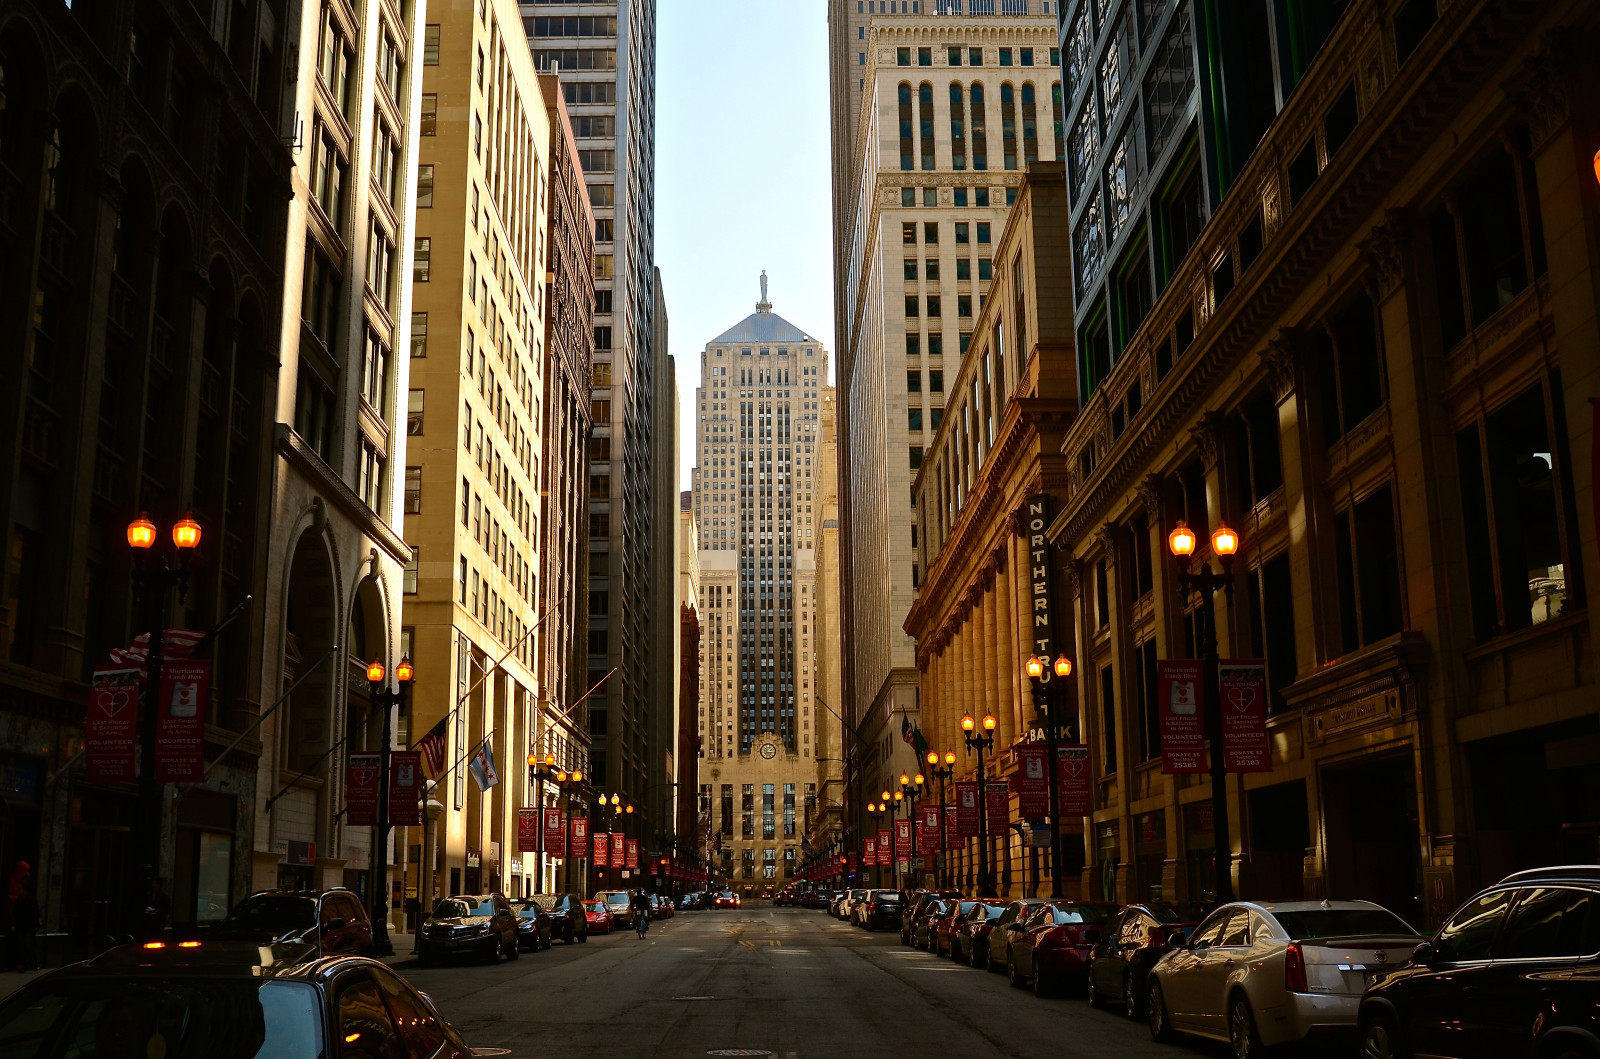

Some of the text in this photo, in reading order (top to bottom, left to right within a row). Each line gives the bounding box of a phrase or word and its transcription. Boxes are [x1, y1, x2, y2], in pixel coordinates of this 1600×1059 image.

[1030, 502, 1050, 716] NORTHERN TRUT
[1030, 726, 1072, 742] BAK
[1173, 761, 1197, 769] 25383
